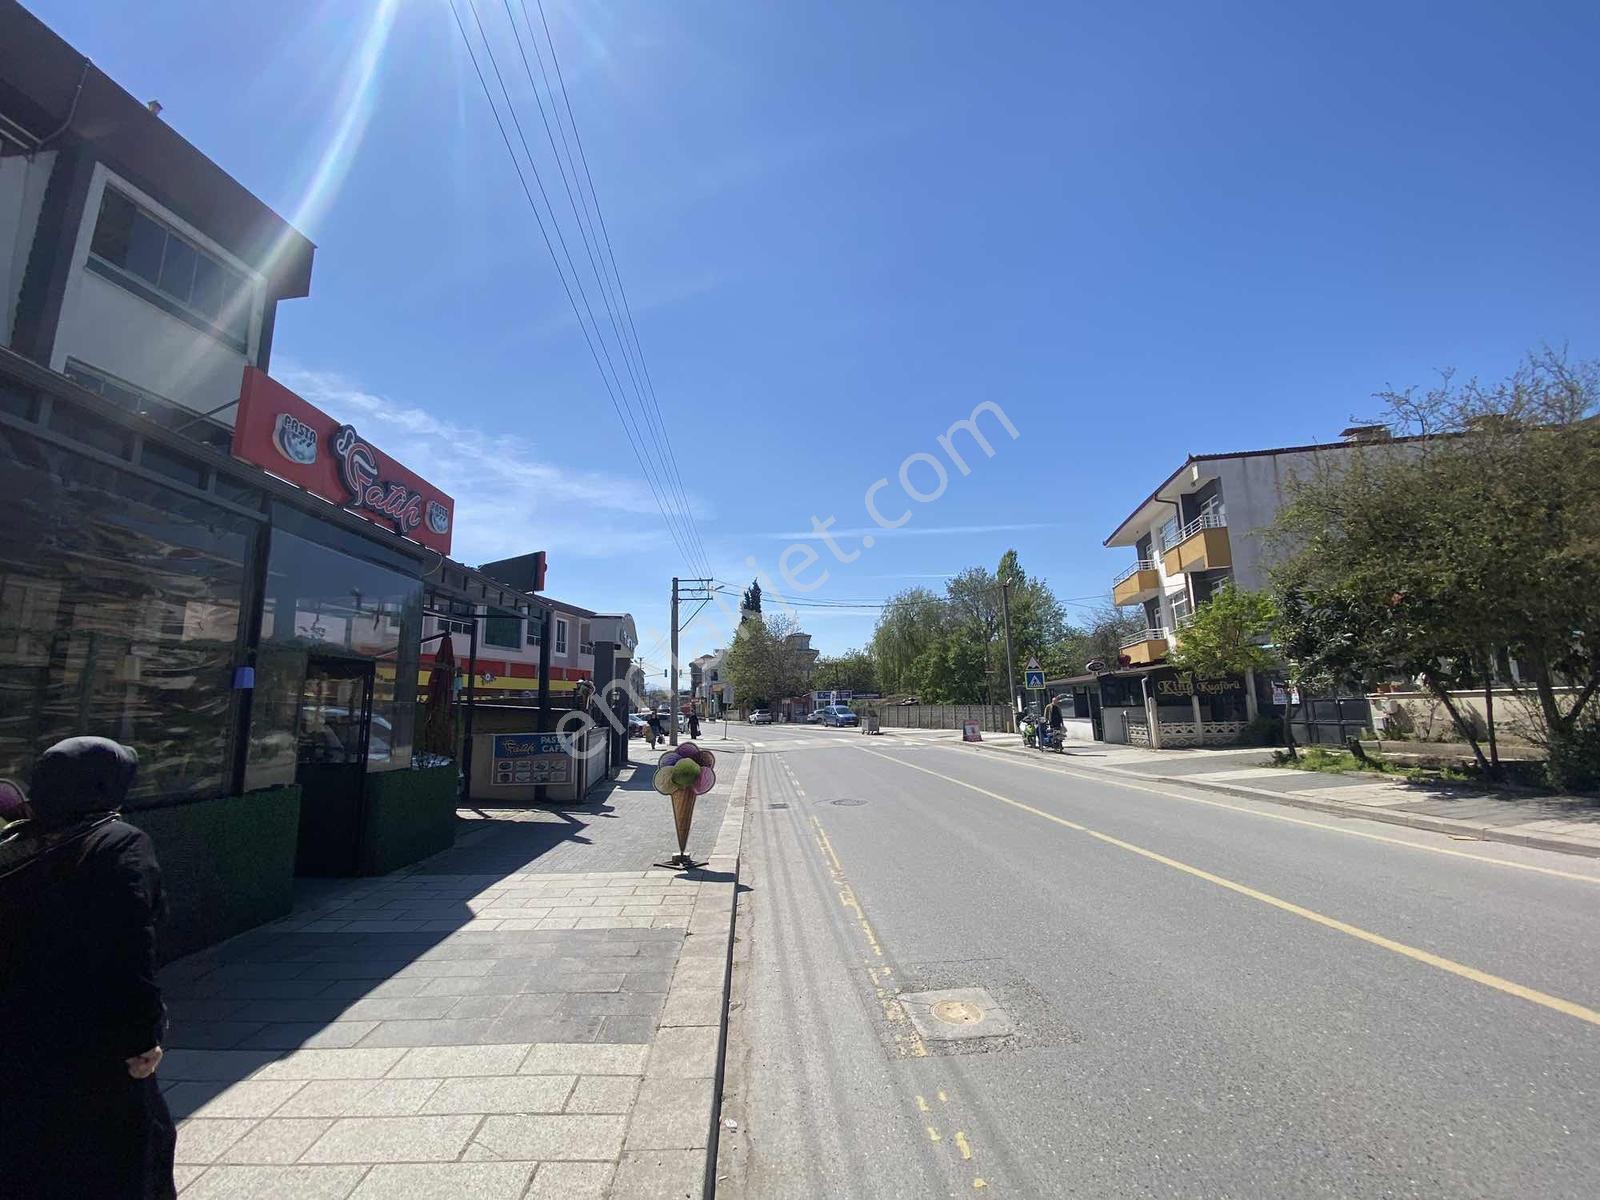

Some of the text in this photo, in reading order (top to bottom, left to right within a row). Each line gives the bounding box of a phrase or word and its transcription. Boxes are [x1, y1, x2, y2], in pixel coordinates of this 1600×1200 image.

[284, 414, 316, 443] PASTA
[337, 429, 421, 533] Fatih
[1158, 679, 1194, 696] King
